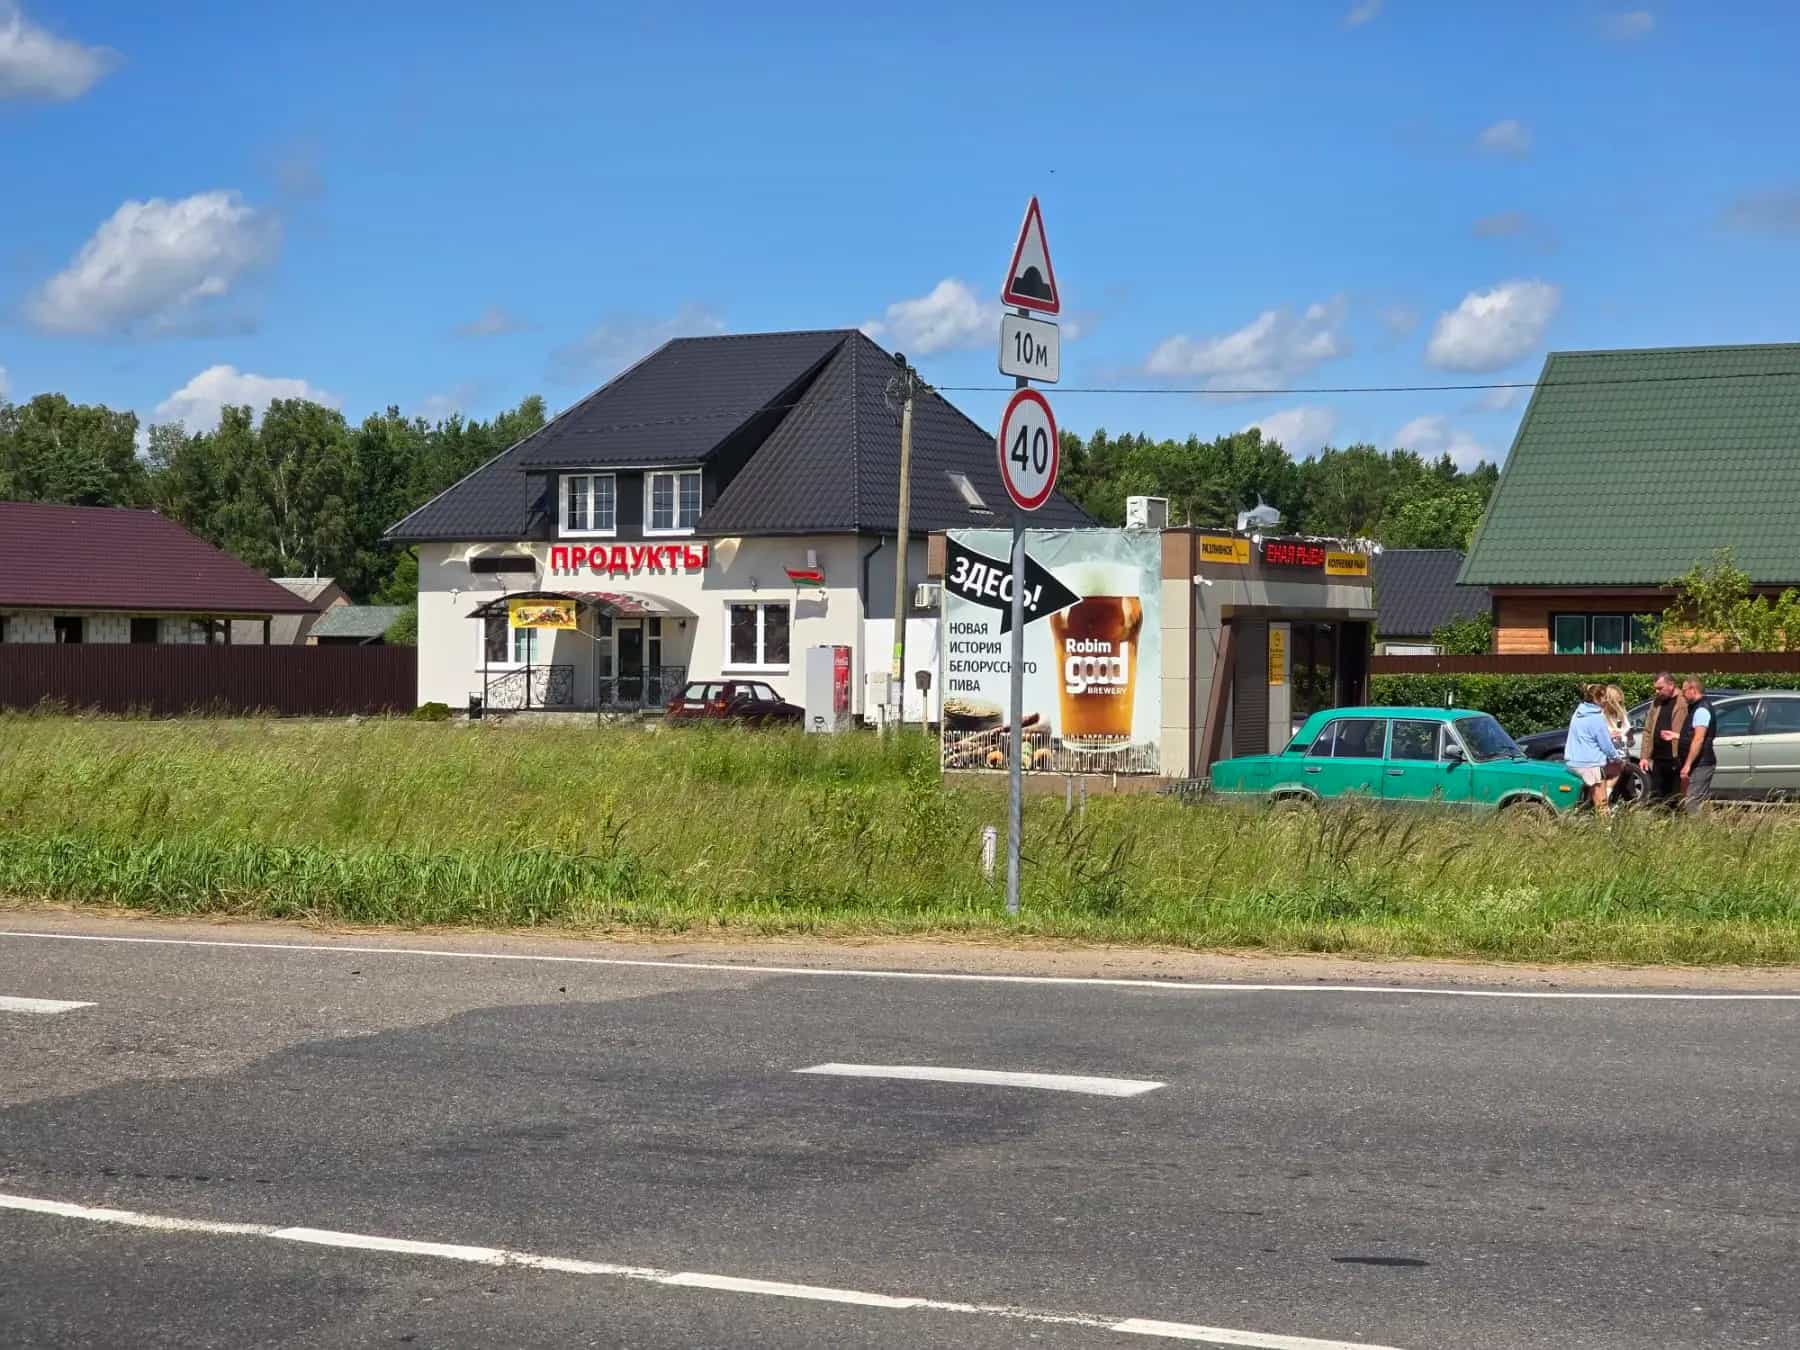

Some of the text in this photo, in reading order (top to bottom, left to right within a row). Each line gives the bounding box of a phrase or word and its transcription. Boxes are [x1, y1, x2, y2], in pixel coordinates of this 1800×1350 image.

[1011, 425, 1048, 474] 40
[550, 545, 709, 575] ПРОДУКТЫ
[949, 622, 989, 635] НОВАЯ
[949, 640, 1002, 655] ИСТОРИЯ
[1065, 637, 1112, 654] Robim
[949, 660, 1038, 674] БЕЛОРУССГО
[1065, 641, 1129, 695] good
[949, 679, 981, 692] ПИВА
[1087, 686, 1129, 695] BREWERY
